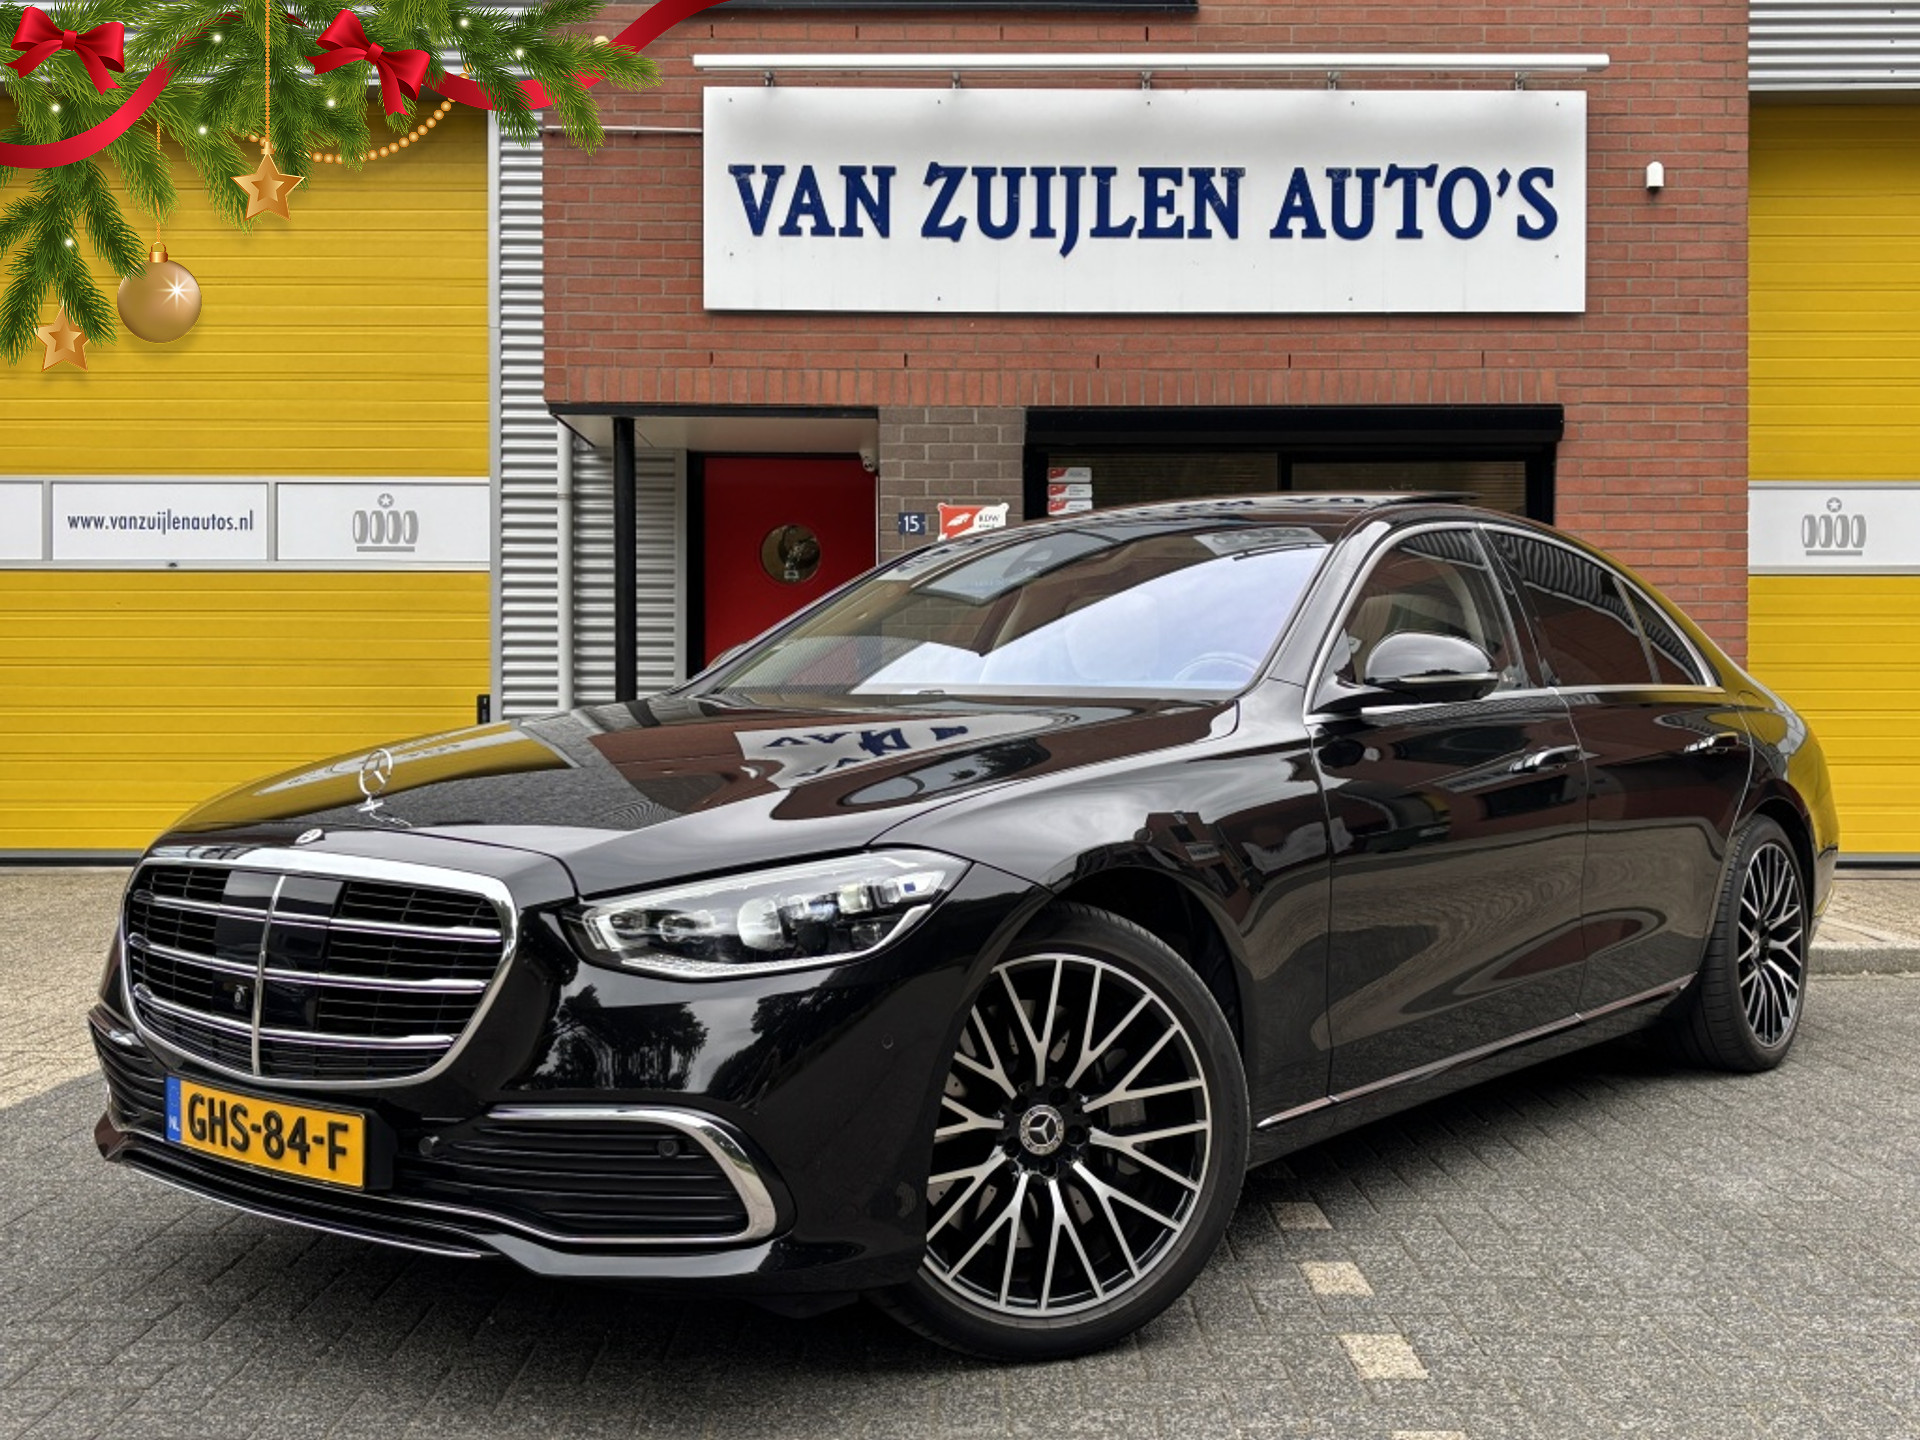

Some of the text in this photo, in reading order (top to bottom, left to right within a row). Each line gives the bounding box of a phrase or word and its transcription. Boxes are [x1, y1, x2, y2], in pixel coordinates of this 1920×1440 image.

[728, 161, 1558, 259] VAN ZUIJLEN AUTO'S
[67, 509, 253, 535] www.vanzuijlenautos.nl
[903, 515, 920, 532] 15
[187, 1093, 348, 1170] GHS-84-F
